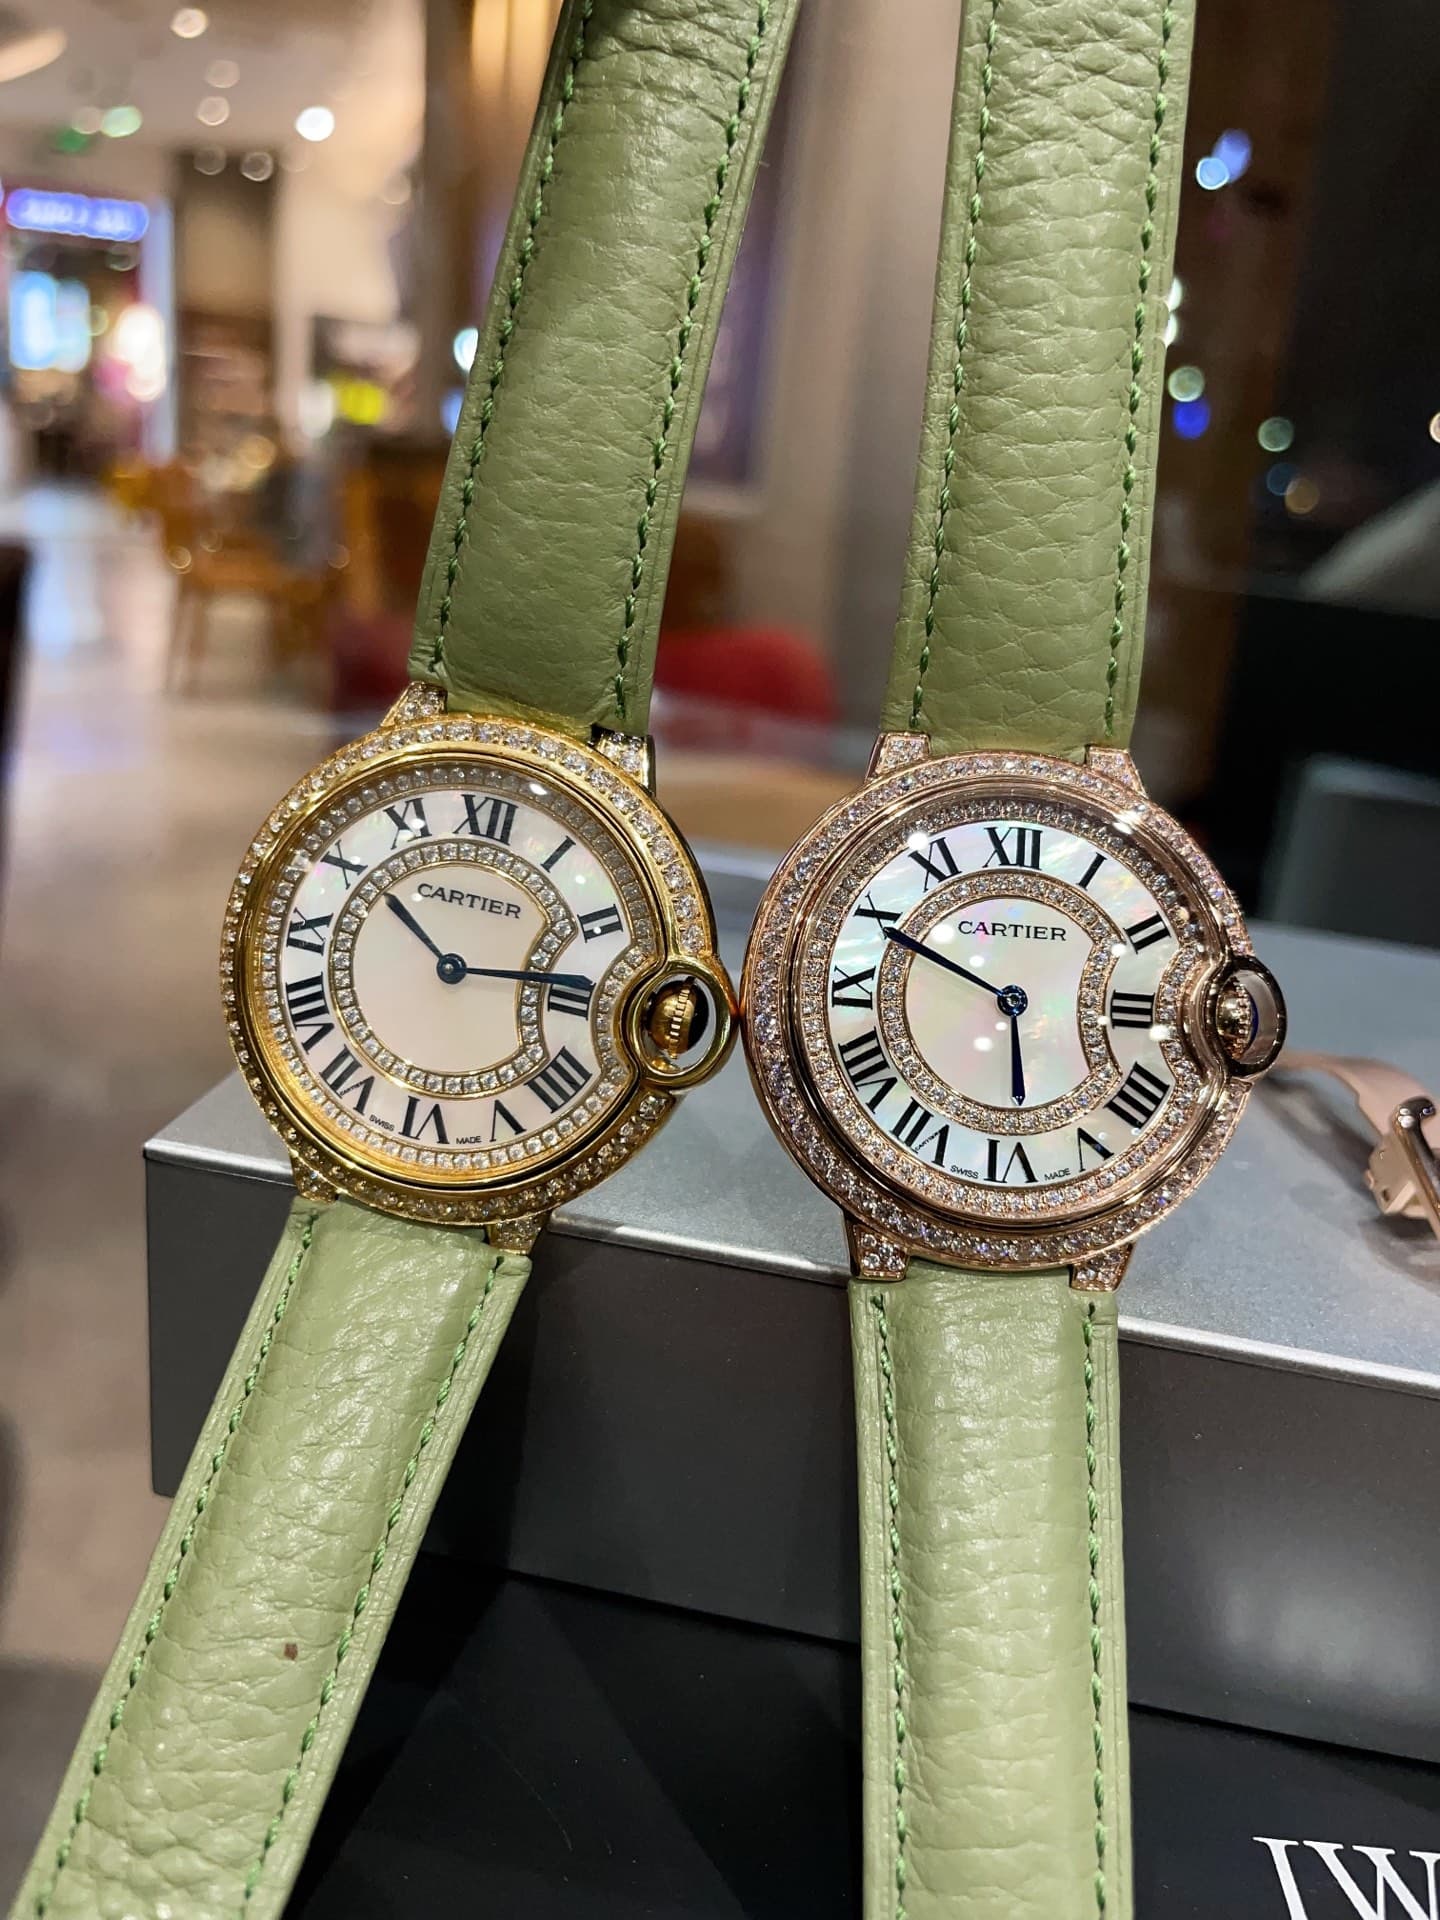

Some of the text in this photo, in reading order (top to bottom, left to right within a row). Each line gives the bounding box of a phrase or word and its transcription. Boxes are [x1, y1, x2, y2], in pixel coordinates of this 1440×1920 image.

[384, 797, 432, 849] XI
[453, 794, 518, 846] XII
[320, 839, 368, 890] X
[541, 836, 576, 872] I
[908, 837, 962, 892] XI
[983, 827, 1042, 870] XII
[1077, 853, 1107, 890] I
[417, 883, 521, 919] CARTIER
[577, 904, 623, 943] II
[854, 892, 903, 939] X
[286, 907, 334, 956] IX
[958, 920, 1066, 942] CARTIER
[1123, 912, 1171, 954] II
[832, 966, 876, 1010] IX
[1111, 989, 1155, 1029] III
[285, 971, 334, 1055] VIII
[319, 1044, 375, 1116] VII
[524, 1046, 592, 1113] IIII
[838, 1027, 898, 1114] VIII
[1104, 1062, 1170, 1128] IIII
[369, 1114, 482, 1145] SWISS MADE
[398, 1095, 449, 1145] VI
[489, 1099, 526, 1142] V
[889, 1097, 949, 1167] VII
[984, 1138, 1038, 1184] VI
[1077, 1127, 1114, 1171] V
[950, 1165, 1072, 1182] SWISS MADE
